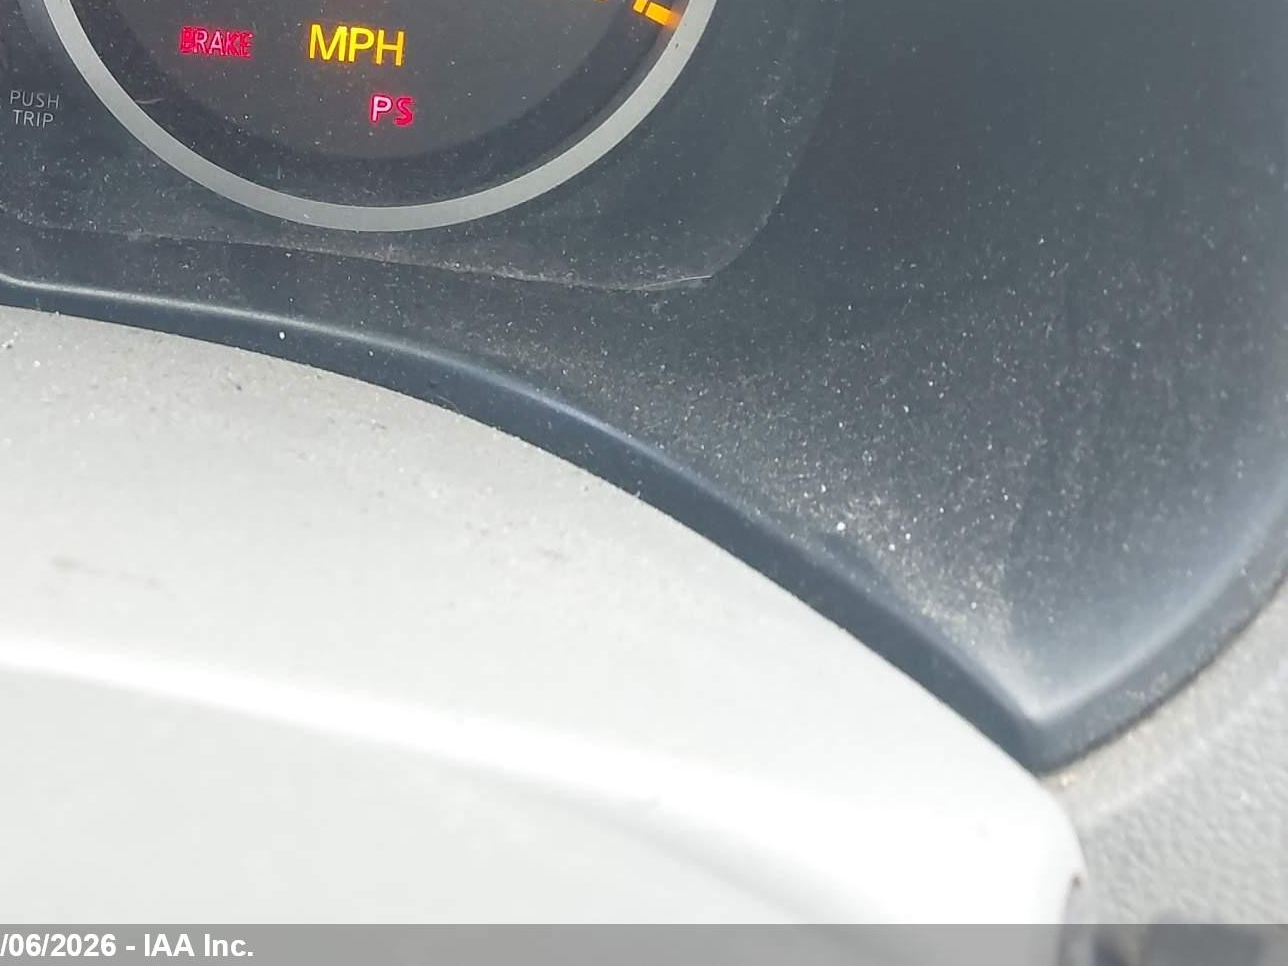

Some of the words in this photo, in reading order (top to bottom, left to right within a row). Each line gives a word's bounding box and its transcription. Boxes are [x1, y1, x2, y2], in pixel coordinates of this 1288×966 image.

[178, 26, 254, 58] BRAKE
[308, 22, 406, 67] MPH
[10, 89, 60, 110] PUSH
[368, 93, 414, 126] PS
[12, 109, 54, 129] TRIP
